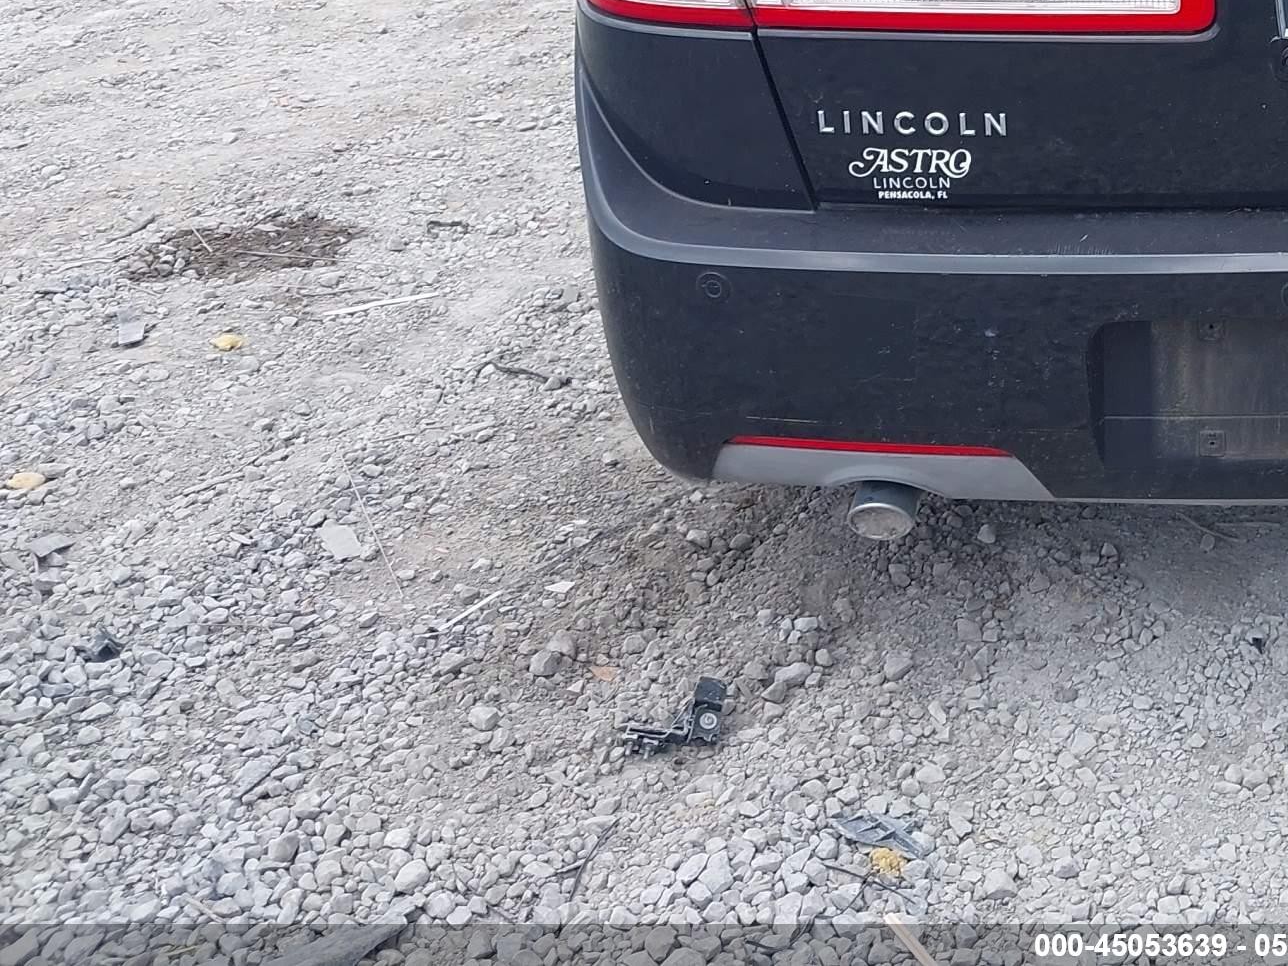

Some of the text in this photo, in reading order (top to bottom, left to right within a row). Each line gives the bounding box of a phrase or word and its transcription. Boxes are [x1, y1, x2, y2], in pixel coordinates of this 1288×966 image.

[817, 109, 1008, 137] LINCOLN
[849, 147, 972, 178] ASTRO
[873, 177, 951, 189] LINCOLN
[878, 190, 949, 200] PENSACOLA, FL
